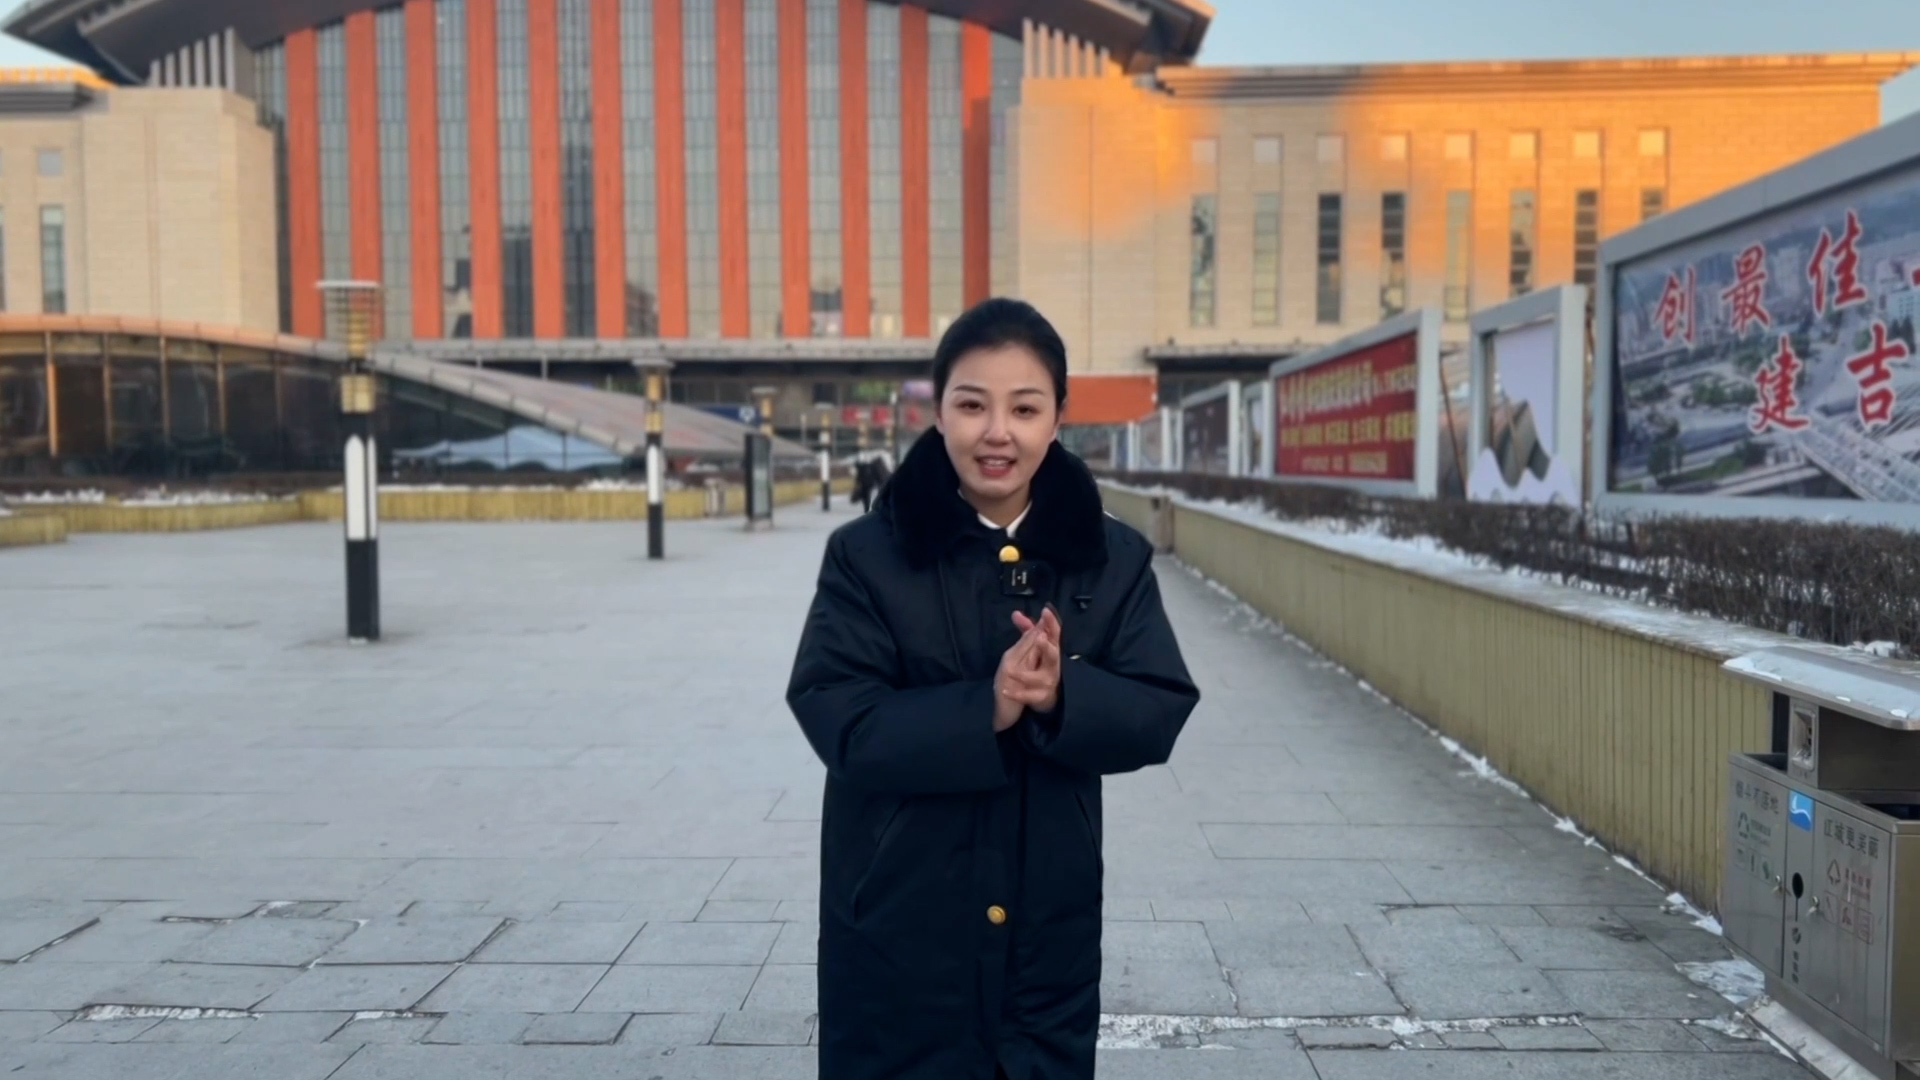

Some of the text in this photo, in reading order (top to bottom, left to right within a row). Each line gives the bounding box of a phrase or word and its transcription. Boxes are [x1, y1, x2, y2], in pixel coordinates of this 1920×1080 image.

[1653, 209, 1920, 345] 创最佳
[1750, 321, 1908, 432] 建吉
